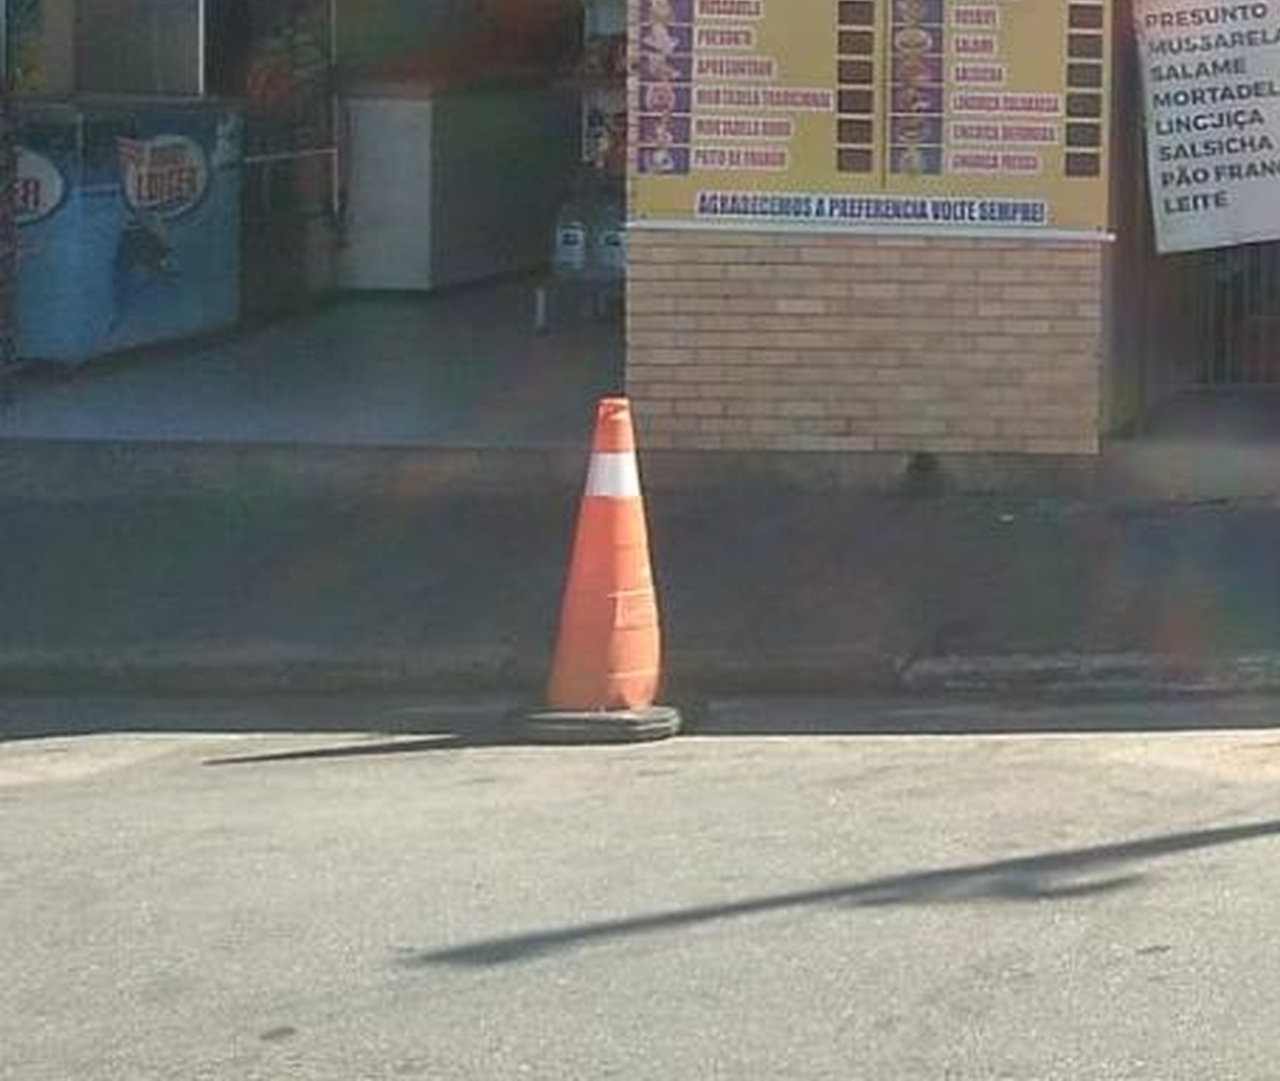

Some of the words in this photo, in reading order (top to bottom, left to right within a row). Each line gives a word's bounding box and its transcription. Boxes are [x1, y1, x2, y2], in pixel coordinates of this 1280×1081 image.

[1145, 3, 1267, 29] PRESUNTO
[1150, 57, 1247, 82] SALAME
[1159, 135, 1274, 162] SALSICHA
[1161, 165, 1209, 188] PÃO
[1163, 191, 1229, 214] LEITE
